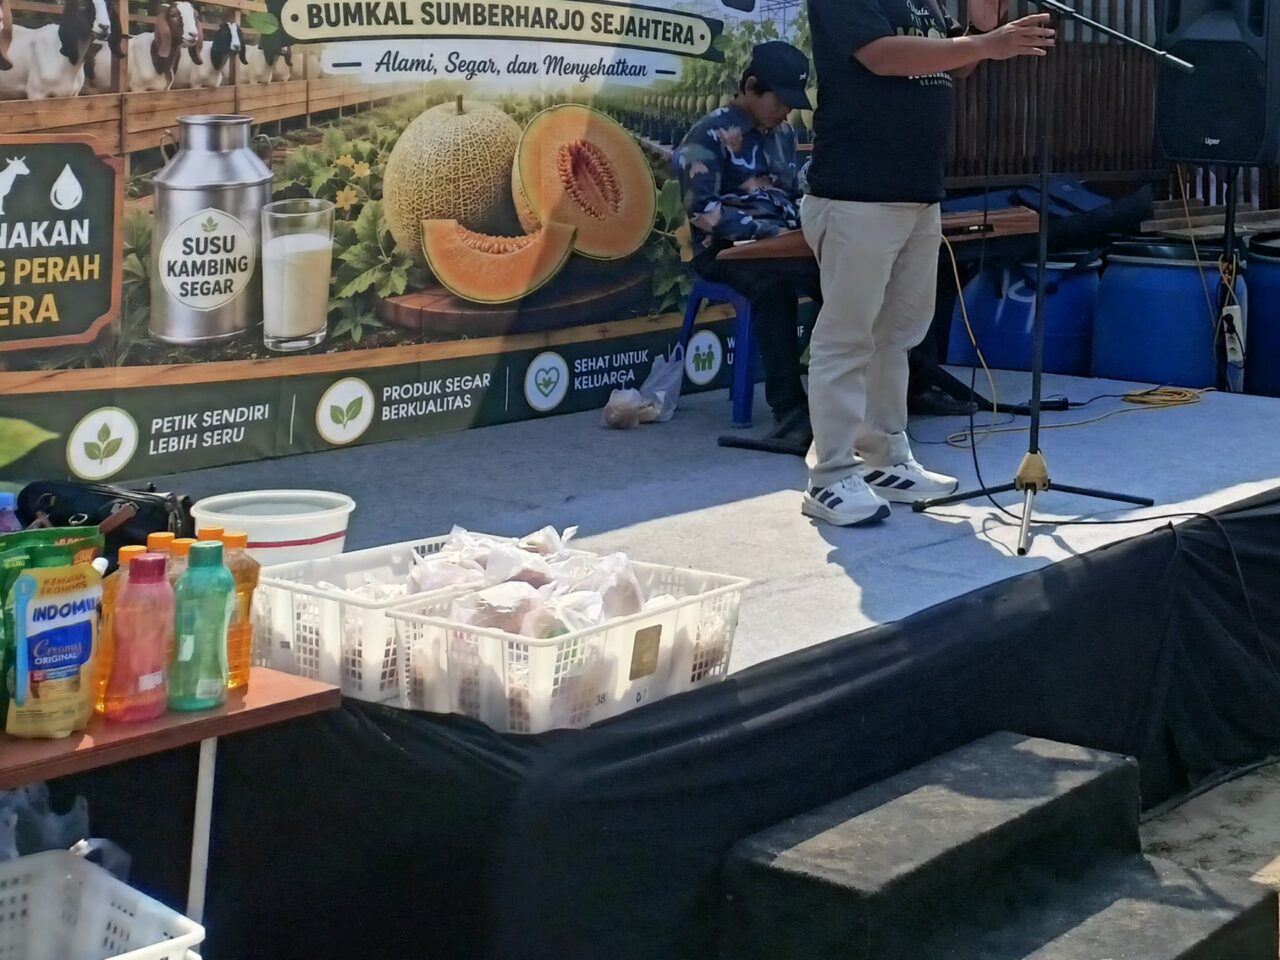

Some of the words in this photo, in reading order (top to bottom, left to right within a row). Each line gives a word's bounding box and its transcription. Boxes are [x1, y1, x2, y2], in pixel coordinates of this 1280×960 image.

[306, 1, 414, 29] BUMKAL
[420, 1, 585, 32] SUMBERHARJO
[590, 11, 695, 46] SEJAHTERA
[374, 50, 438, 75] Alami,
[444, 51, 501, 81] Segar,
[506, 54, 539, 76] dan
[543, 54, 648, 83] Menyehatkan
[182, 234, 236, 256] SUSU
[14, 253, 101, 286] PERAH
[167, 255, 249, 278] KAMBING
[179, 278, 234, 298] SEGAR
[574, 355, 610, 373] SEHAT
[612, 349, 649, 367] UNTUK
[383, 379, 442, 402] PRODUK
[445, 373, 491, 393] SEGAR
[574, 368, 635, 390] KELUARGA
[151, 413, 198, 434] PETIK
[202, 403, 270, 427] SENDIRI
[381, 393, 472, 421] BERKUALITAS
[149, 433, 198, 455] LEBIH
[202, 427, 245, 447] SERU
[33, 639, 82, 658] Creamy
[34, 652, 77, 665] ORIGINAL
